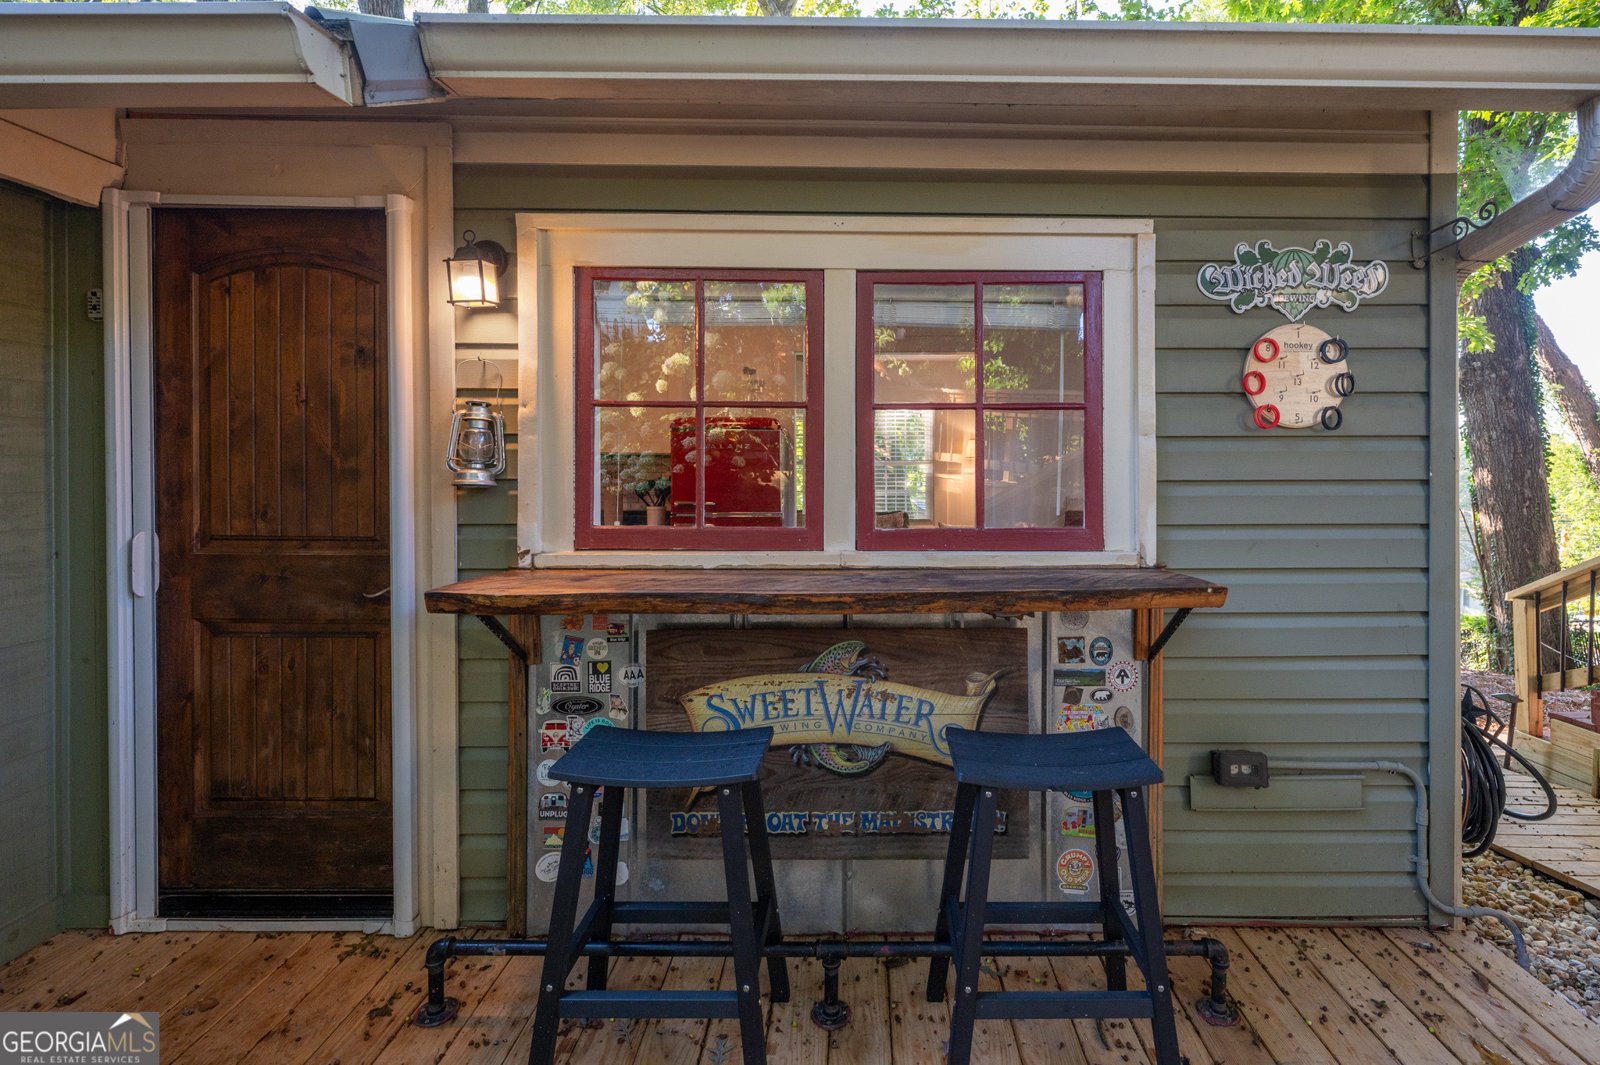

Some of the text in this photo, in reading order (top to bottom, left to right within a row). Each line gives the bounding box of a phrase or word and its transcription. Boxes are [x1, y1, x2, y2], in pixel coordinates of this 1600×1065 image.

[1211, 260, 1378, 295] Wicked Weed
[1283, 342, 1313, 350] hookey
[1278, 361, 1286, 369] 11
[1310, 361, 1319, 369] 12
[1293, 378, 1302, 386] 13
[1278, 394, 1284, 402] 9
[1309, 395, 1319, 403] 10
[588, 674, 611, 683] BLUE
[588, 683, 611, 692] RIDGE
[780, 722, 928, 741] WING COMPANY
[1061, 852, 1090, 866] GRUMPY
[1061, 869, 1090, 883] OLD MEN
